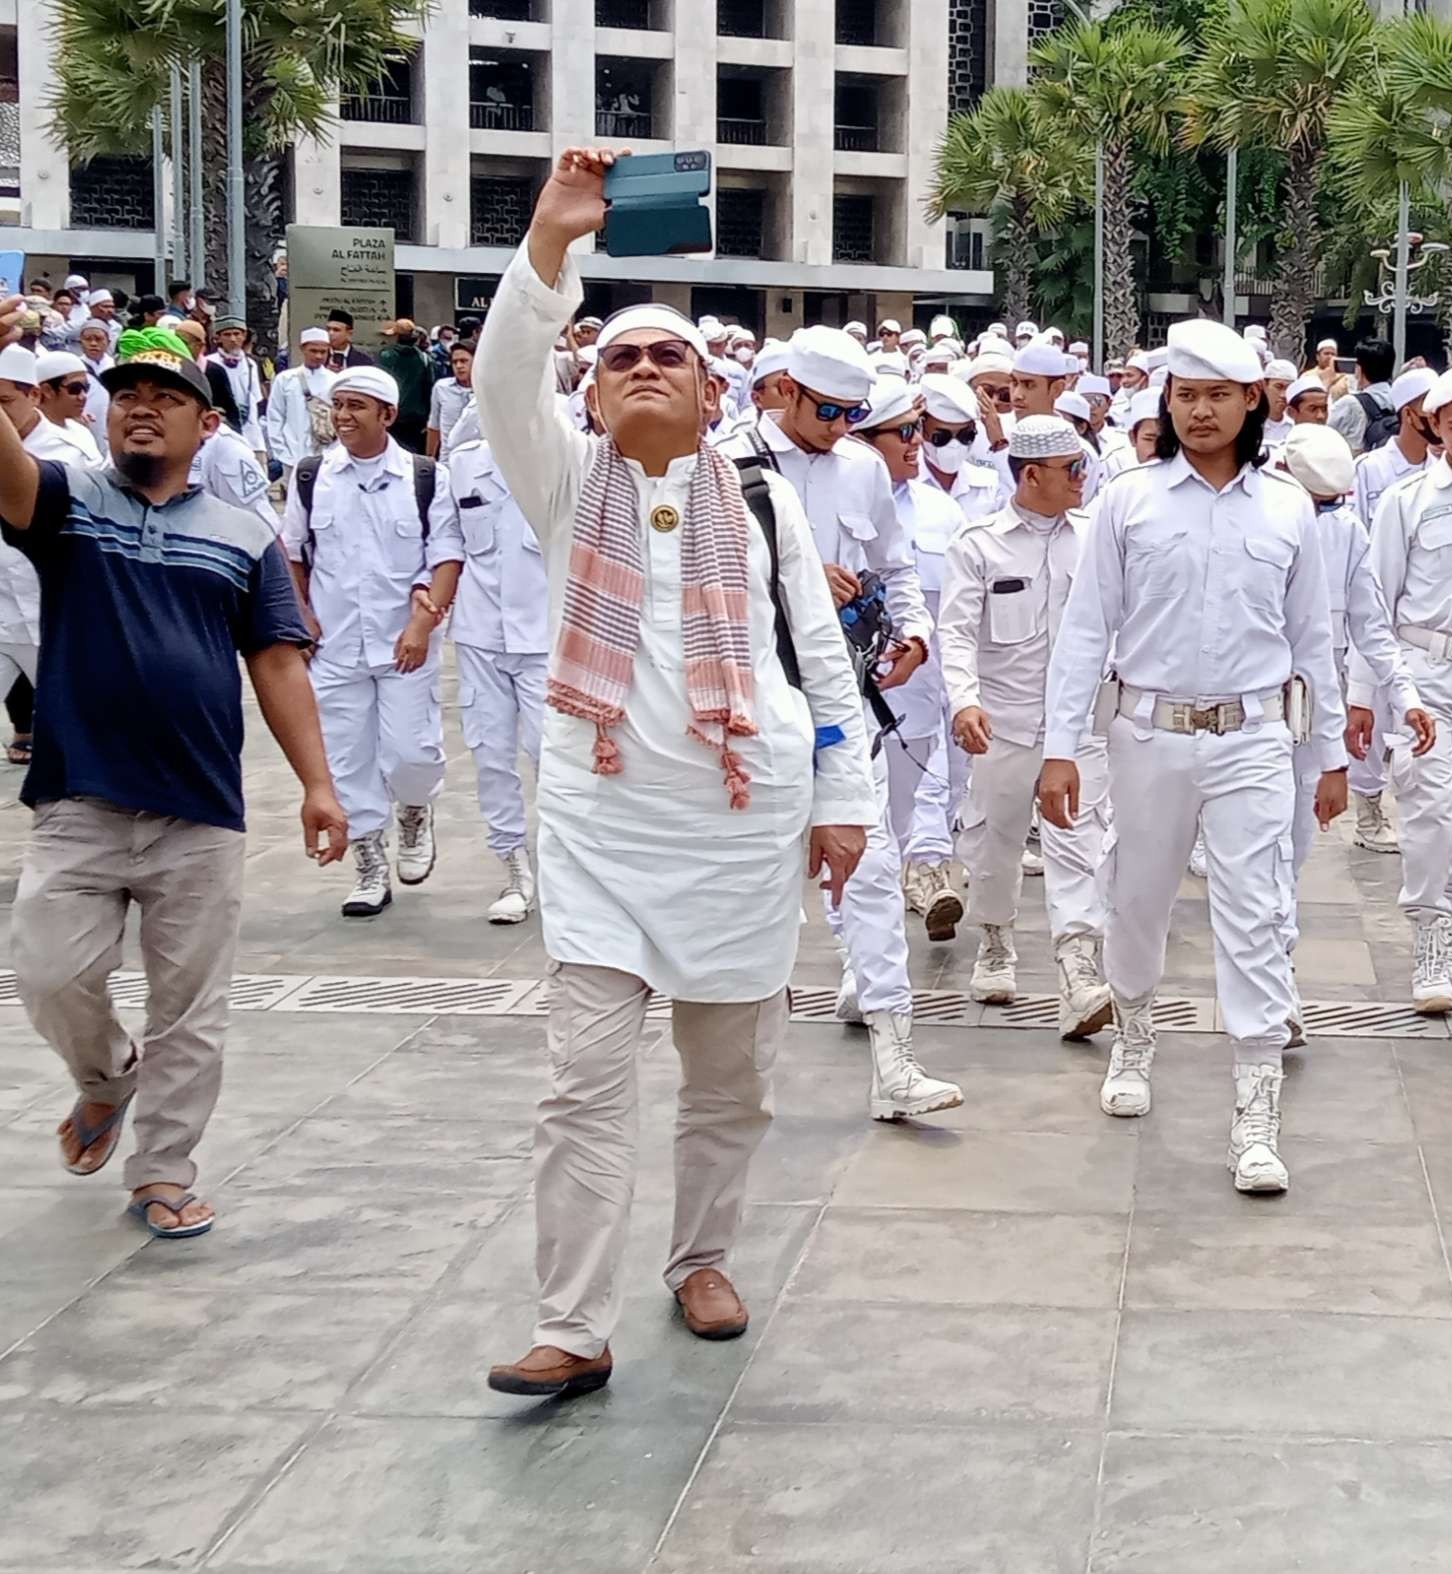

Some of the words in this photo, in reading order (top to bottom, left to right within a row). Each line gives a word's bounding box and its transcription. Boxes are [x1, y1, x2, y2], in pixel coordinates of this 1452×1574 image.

[353, 238, 385, 248] PLAZA
[331, 249, 345, 259] AL
[347, 250, 385, 260] FATTAH
[471, 296, 488, 308] AL
